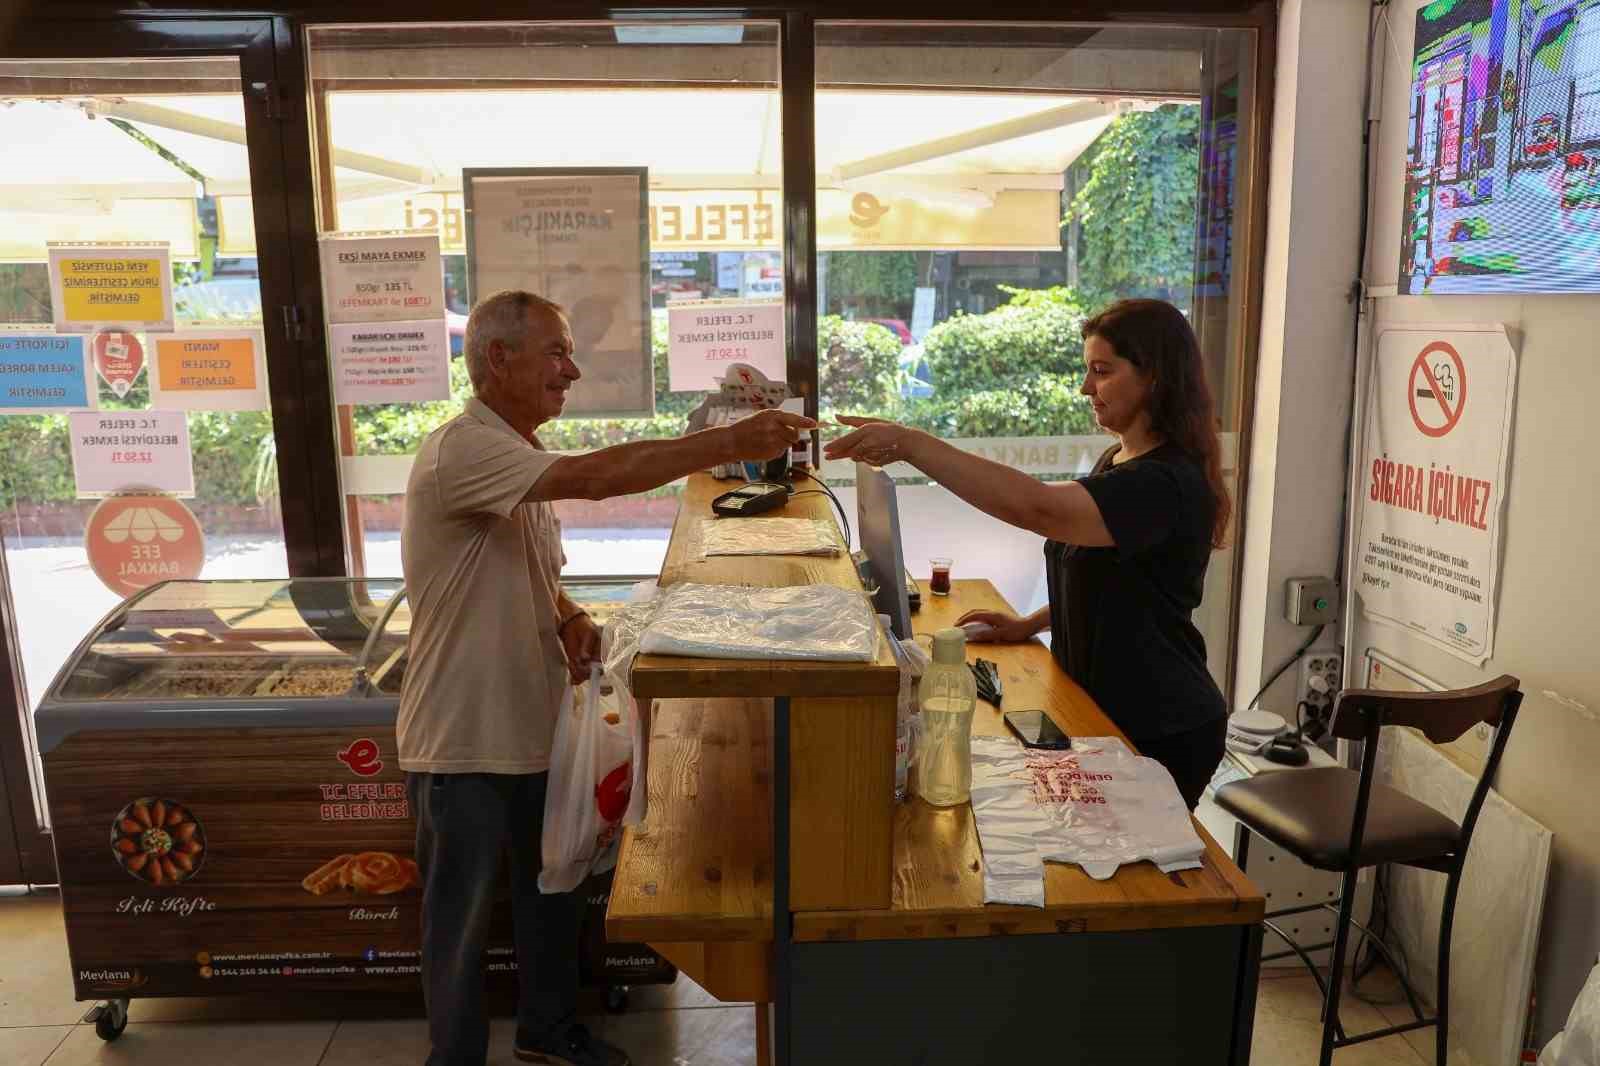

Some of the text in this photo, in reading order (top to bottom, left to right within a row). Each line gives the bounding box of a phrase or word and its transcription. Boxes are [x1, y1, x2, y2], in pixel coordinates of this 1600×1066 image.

[361, 251, 391, 261] MAYA
[393, 250, 426, 260] EKMEK
[1370, 453, 1491, 531] SİGARA İÇİLMEZ
[348, 784, 406, 800] EFELER
[320, 800, 409, 820] BELEDİYESİ
[605, 956, 656, 967] Mevlana
[80, 969, 130, 981] Mevlana
